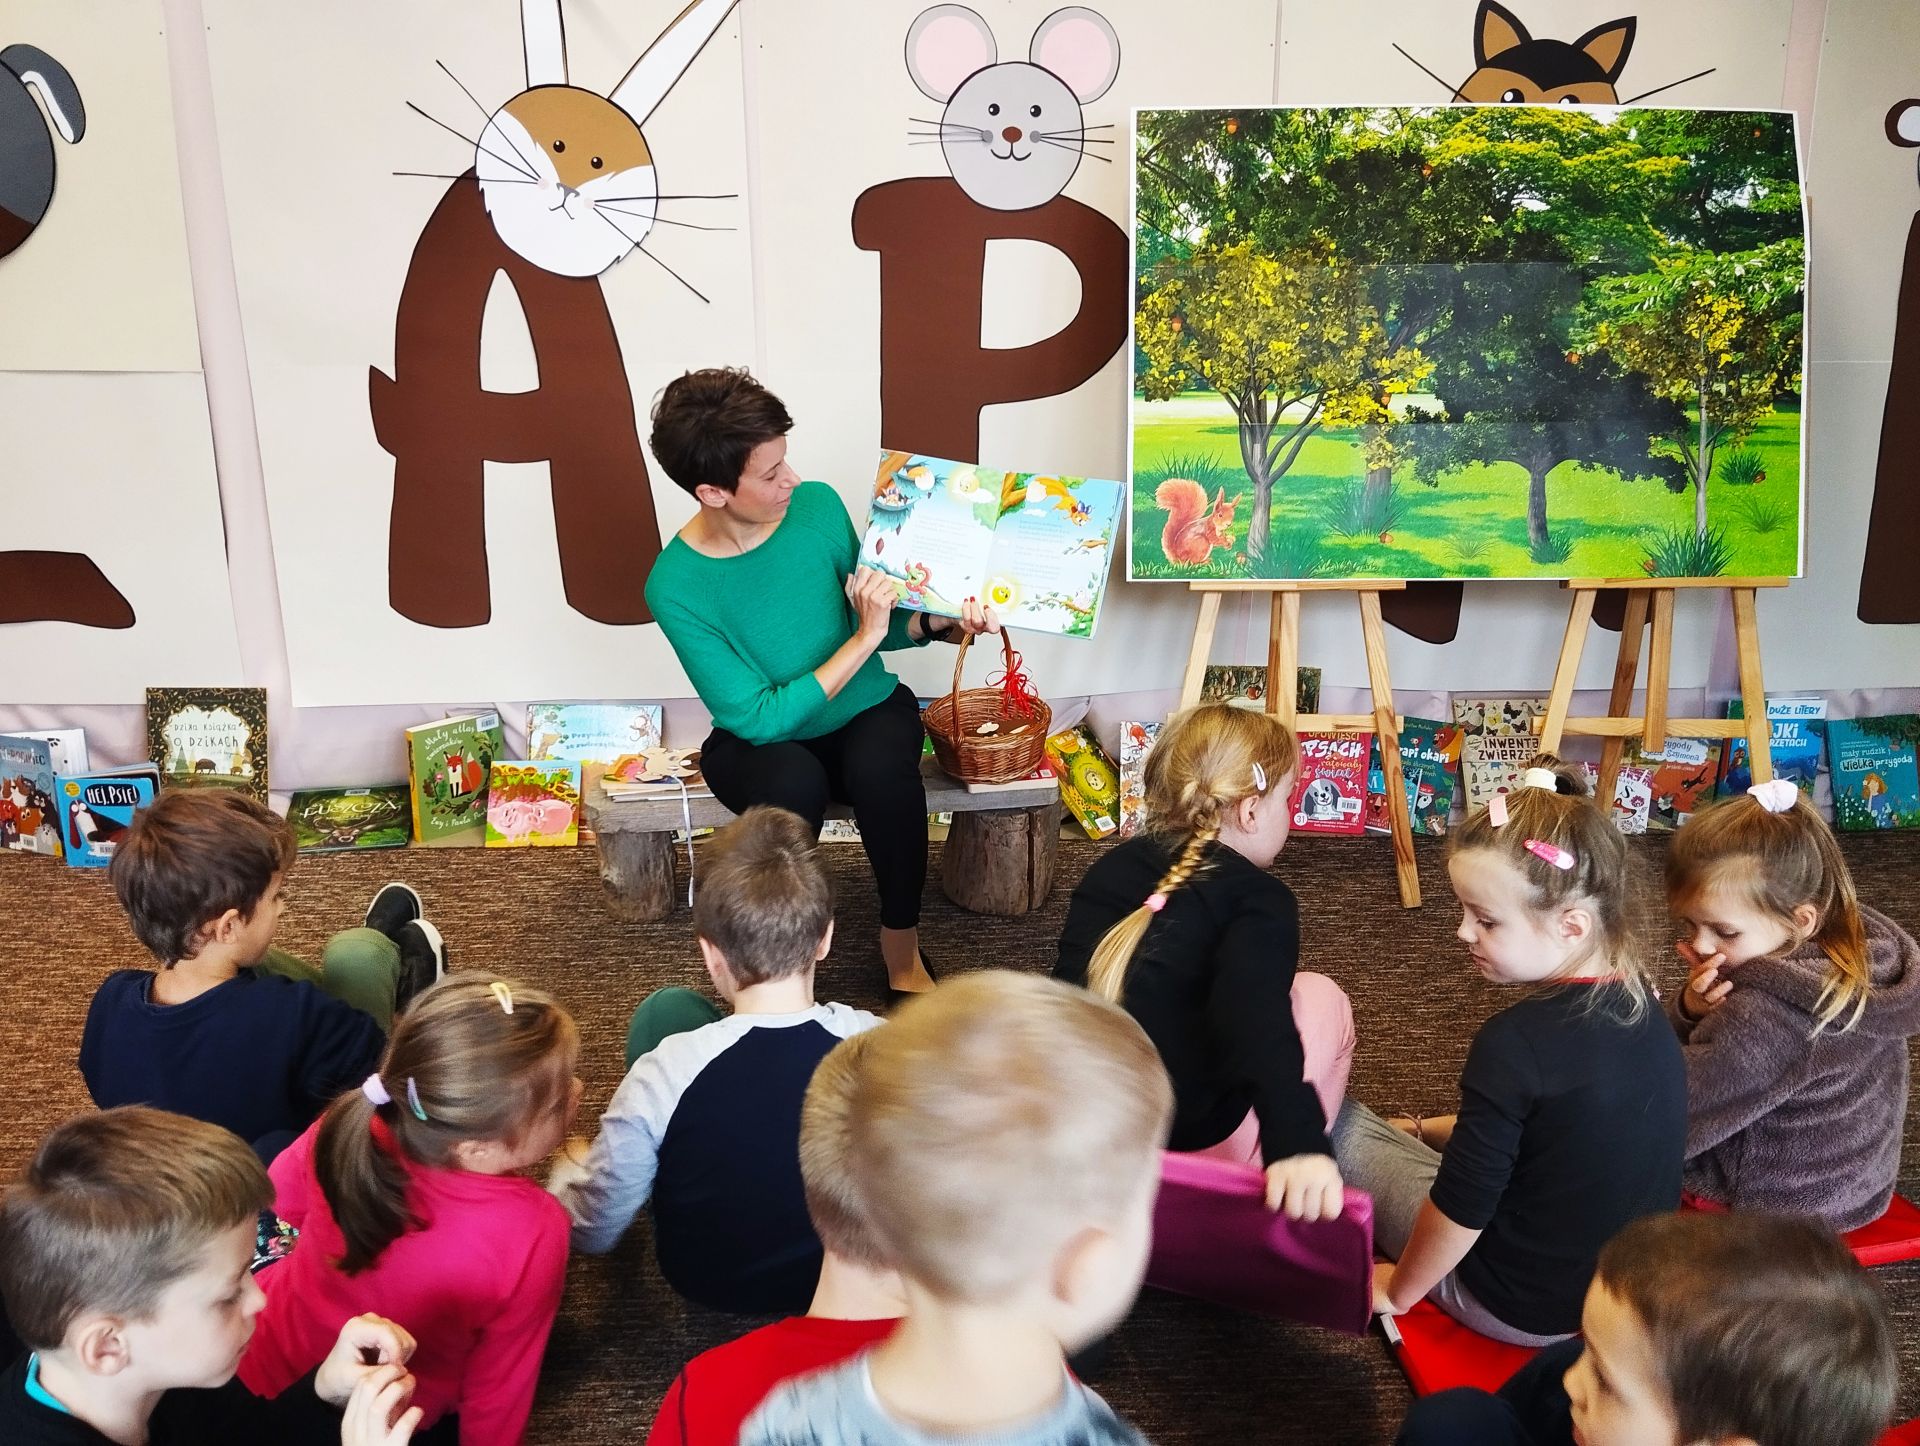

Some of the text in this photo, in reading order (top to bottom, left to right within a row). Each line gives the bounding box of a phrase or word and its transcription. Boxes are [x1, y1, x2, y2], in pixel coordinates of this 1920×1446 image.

[369, 162, 662, 628] A
[851, 176, 1130, 645] P
[1769, 704, 1791, 714] DUŻE
[173, 737, 182, 747] O
[1301, 739, 1363, 758] PSACH
[1420, 749, 1450, 763] okapi
[1666, 749, 1700, 761] Szymona
[1841, 749, 1859, 758] mały
[1875, 755, 1913, 770] przygoda
[1295, 814, 1306, 824] 31
